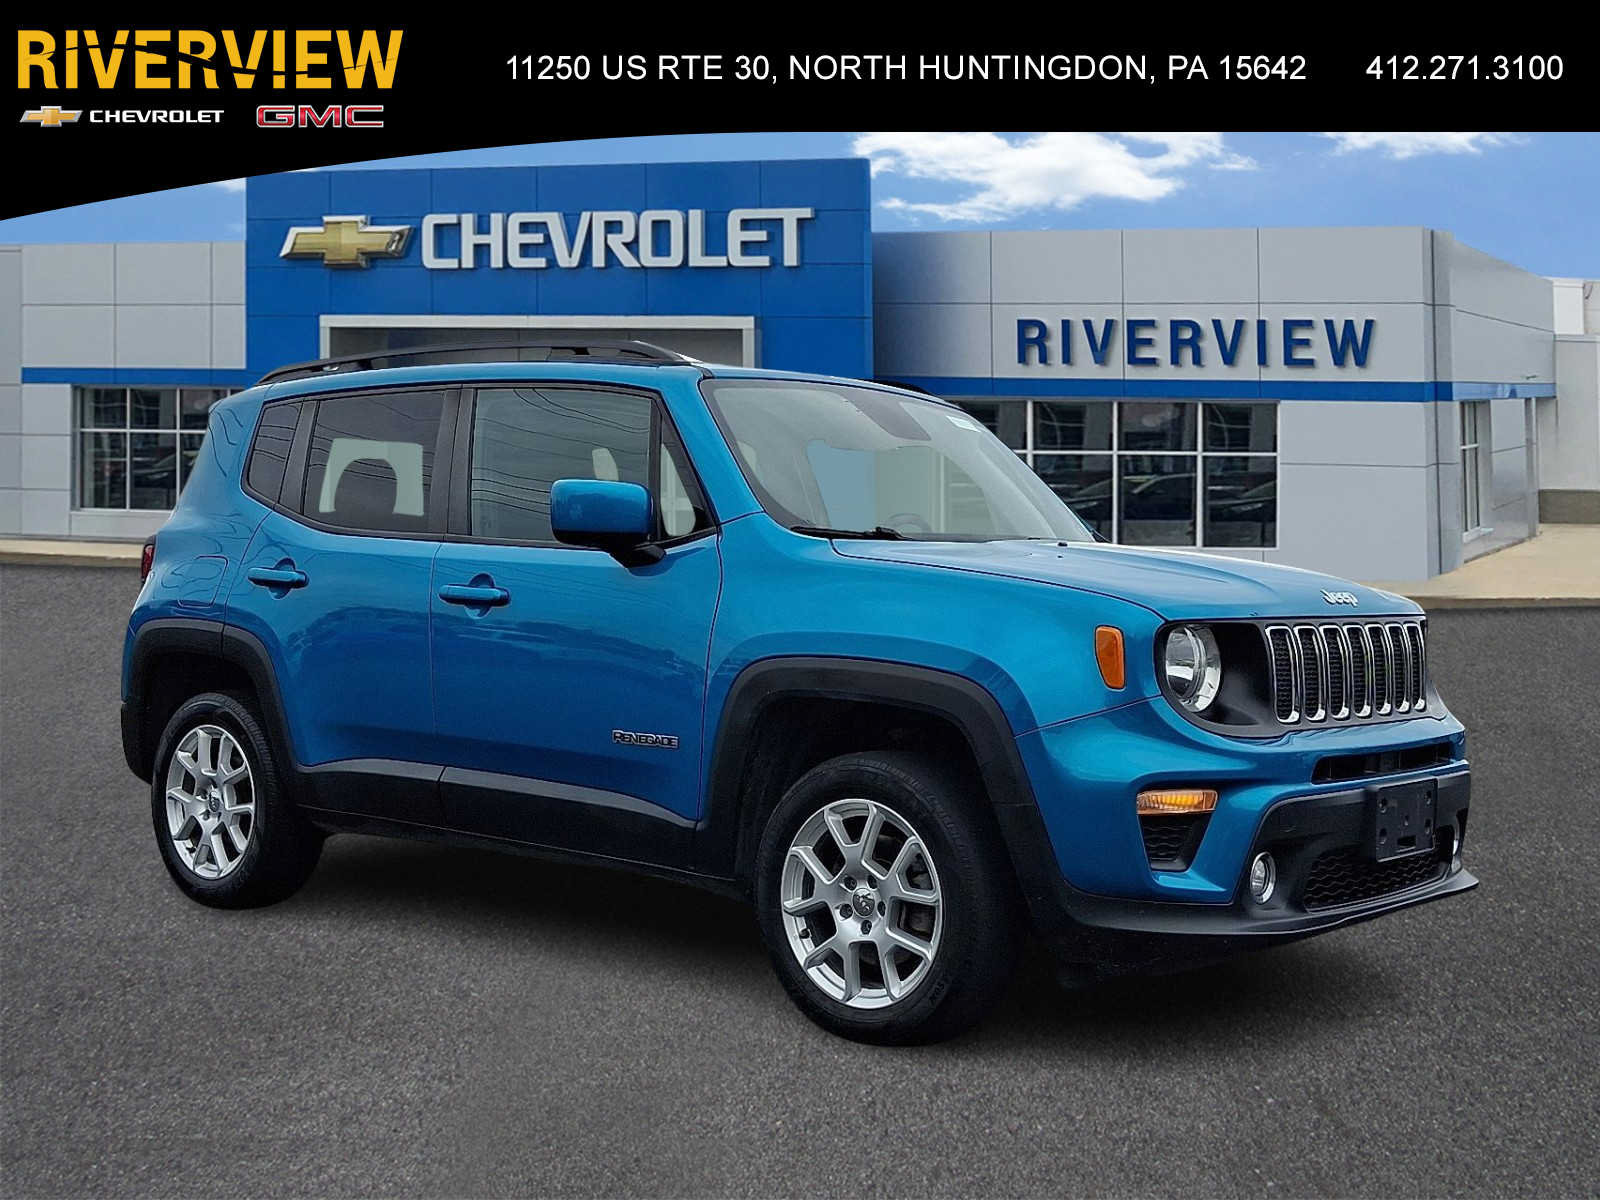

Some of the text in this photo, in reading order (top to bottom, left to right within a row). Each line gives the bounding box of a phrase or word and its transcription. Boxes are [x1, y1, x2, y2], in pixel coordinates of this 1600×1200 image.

[421, 207, 813, 270] CHEVROLET
[1016, 319, 1375, 368] RIVERVIEW
[1320, 589, 1359, 607] Jeep
[611, 728, 680, 750] RENEGADE
